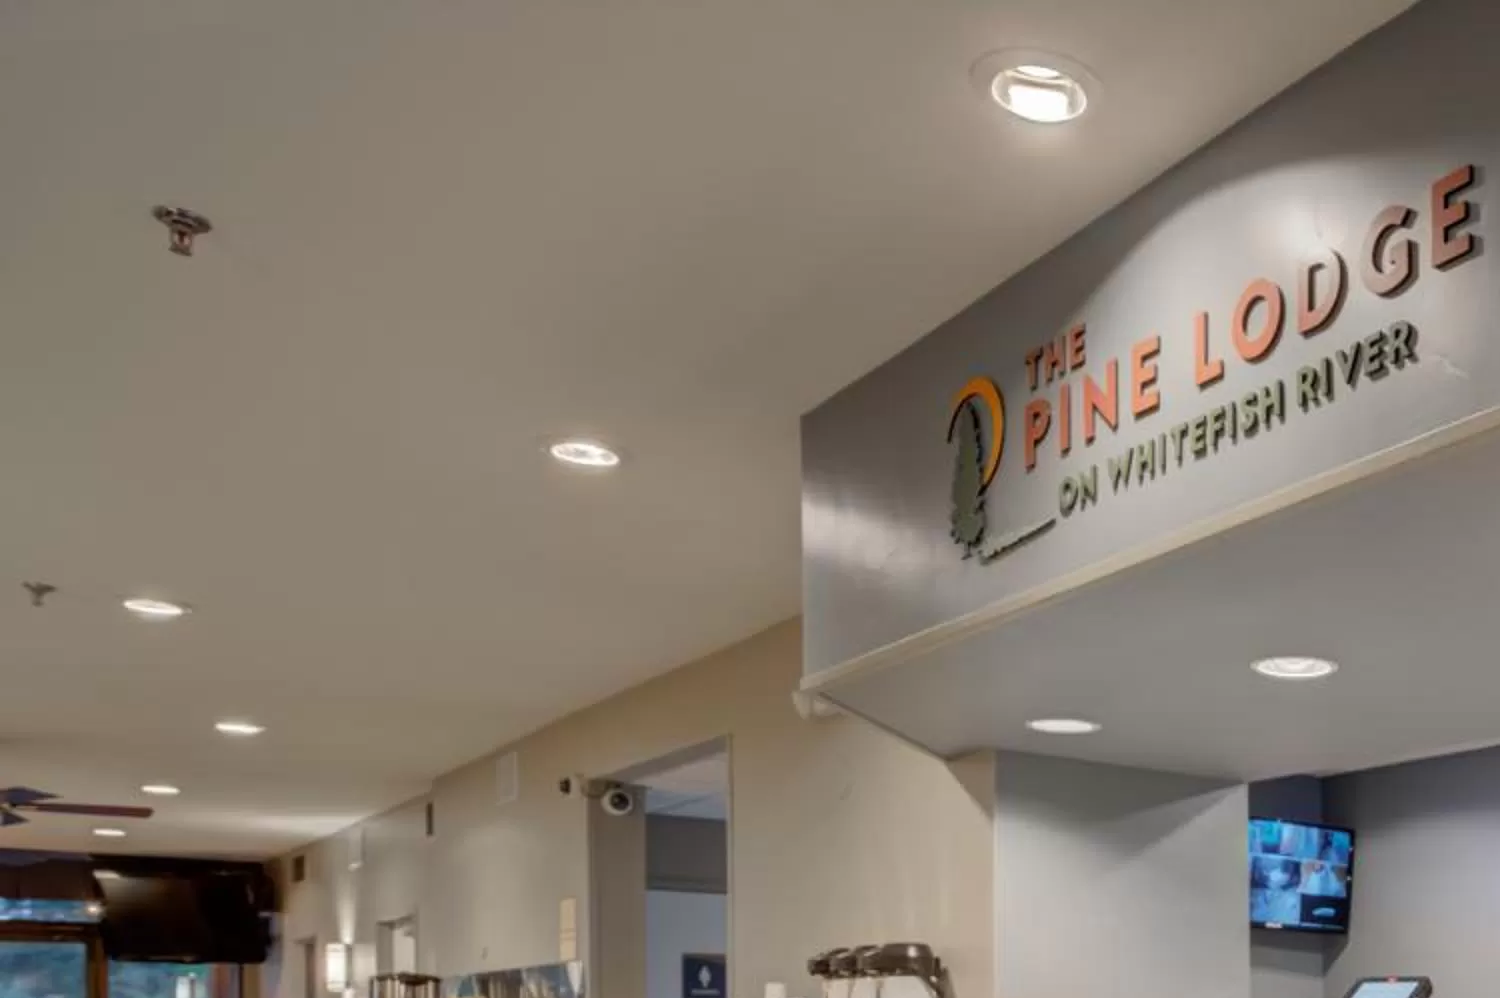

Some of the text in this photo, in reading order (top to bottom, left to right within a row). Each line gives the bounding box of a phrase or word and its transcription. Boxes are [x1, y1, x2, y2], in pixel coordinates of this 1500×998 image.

[1024, 164, 1477, 474] PINE LODGE
[1025, 324, 1086, 391] THE
[1059, 320, 1418, 517] ON WHITEFISH RIVER
